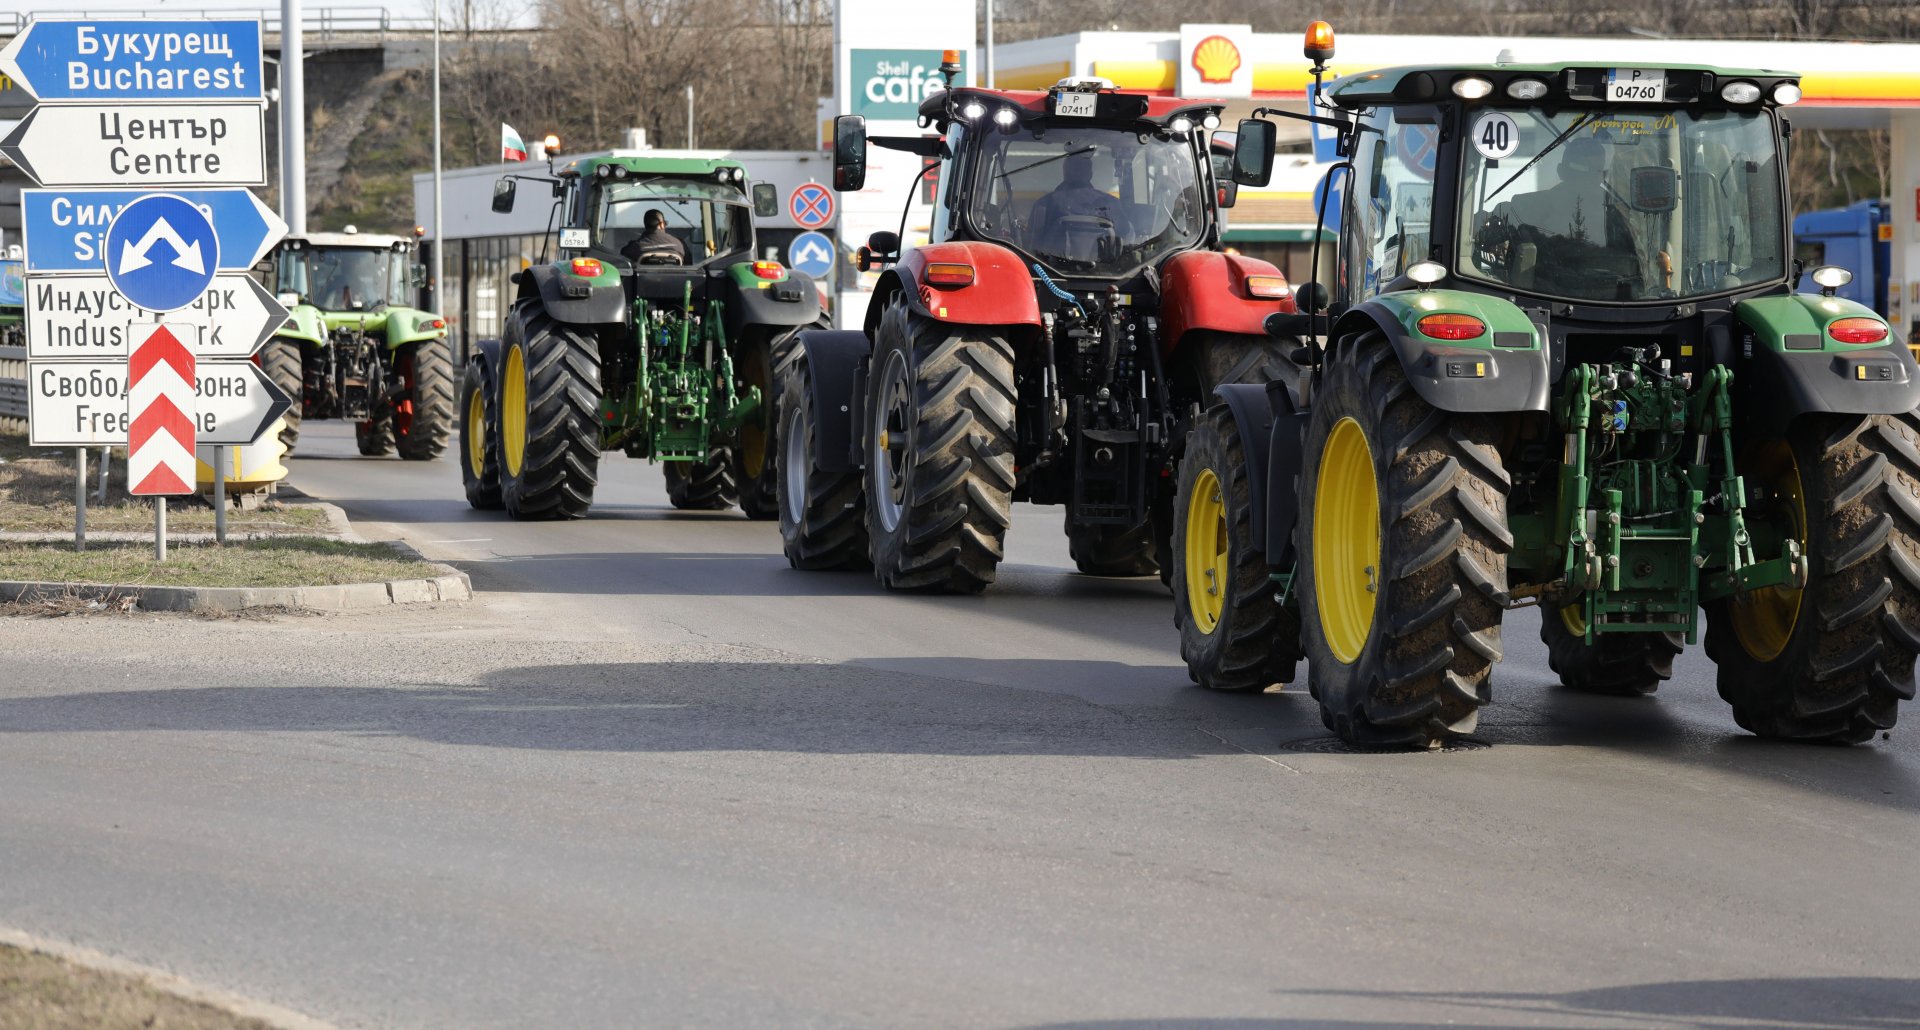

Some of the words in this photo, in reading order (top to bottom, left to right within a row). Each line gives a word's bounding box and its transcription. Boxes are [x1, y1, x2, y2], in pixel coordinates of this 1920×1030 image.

[77, 26, 232, 62] Букурещ
[68, 60, 245, 90] Bucharest
[876, 60, 909, 76] Shell
[865, 65, 945, 103] café
[1616, 86, 1656, 99] 04760
[1061, 105, 1089, 115] 07411
[100, 112, 227, 146] Център
[1481, 120, 1509, 151] 40
[110, 146, 221, 175] Centre
[47, 319, 131, 347] Indus
